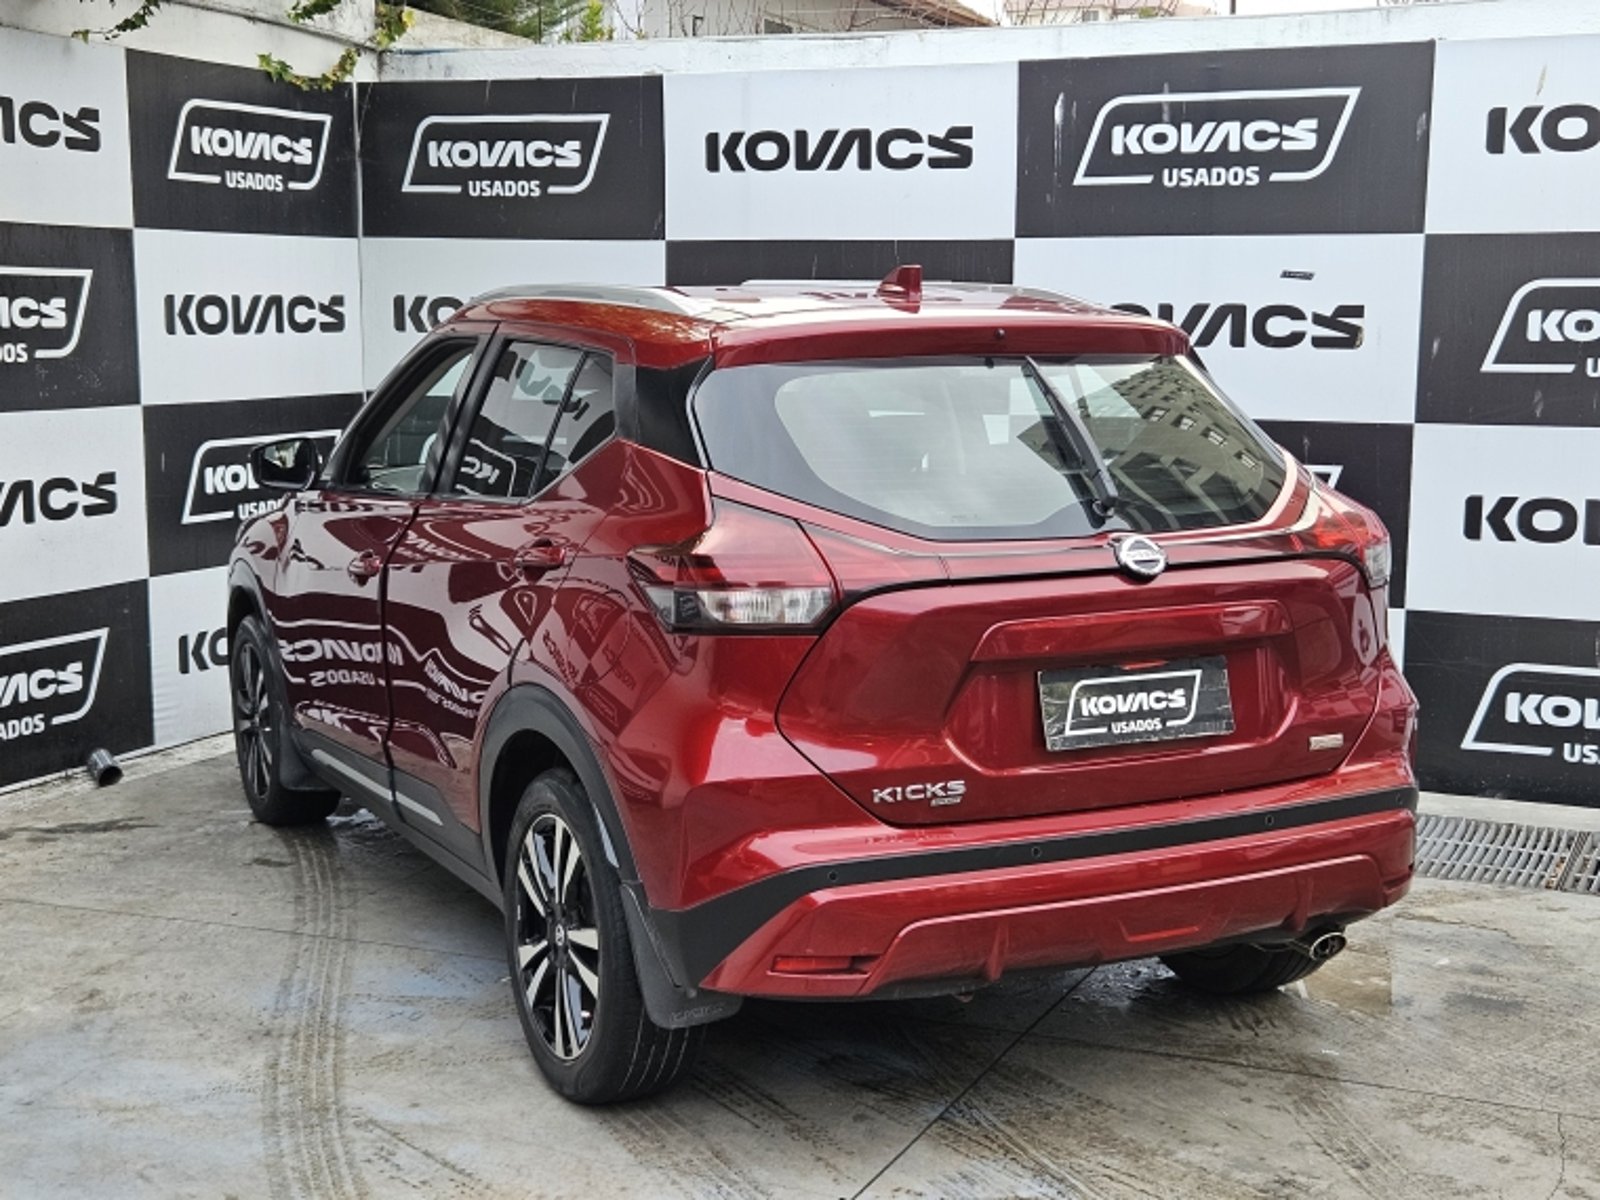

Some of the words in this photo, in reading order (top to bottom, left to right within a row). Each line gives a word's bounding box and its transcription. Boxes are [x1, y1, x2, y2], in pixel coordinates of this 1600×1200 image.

[1110, 117, 1319, 155] KOVACS
[1485, 104, 1600, 154] KO
[190, 125, 313, 165] KOVACS
[427, 140, 582, 168] KOVACS
[705, 125, 973, 173] KOVACS
[225, 170, 283, 192] USADOS
[468, 180, 541, 197] USADOS
[1162, 166, 1260, 187] USADOS
[164, 294, 346, 335] KOVACS
[1526, 309, 1600, 342] KO
[1081, 688, 1187, 717] KOVACS
[1111, 717, 1163, 734] USADOS
[872, 780, 966, 804] KICKS
